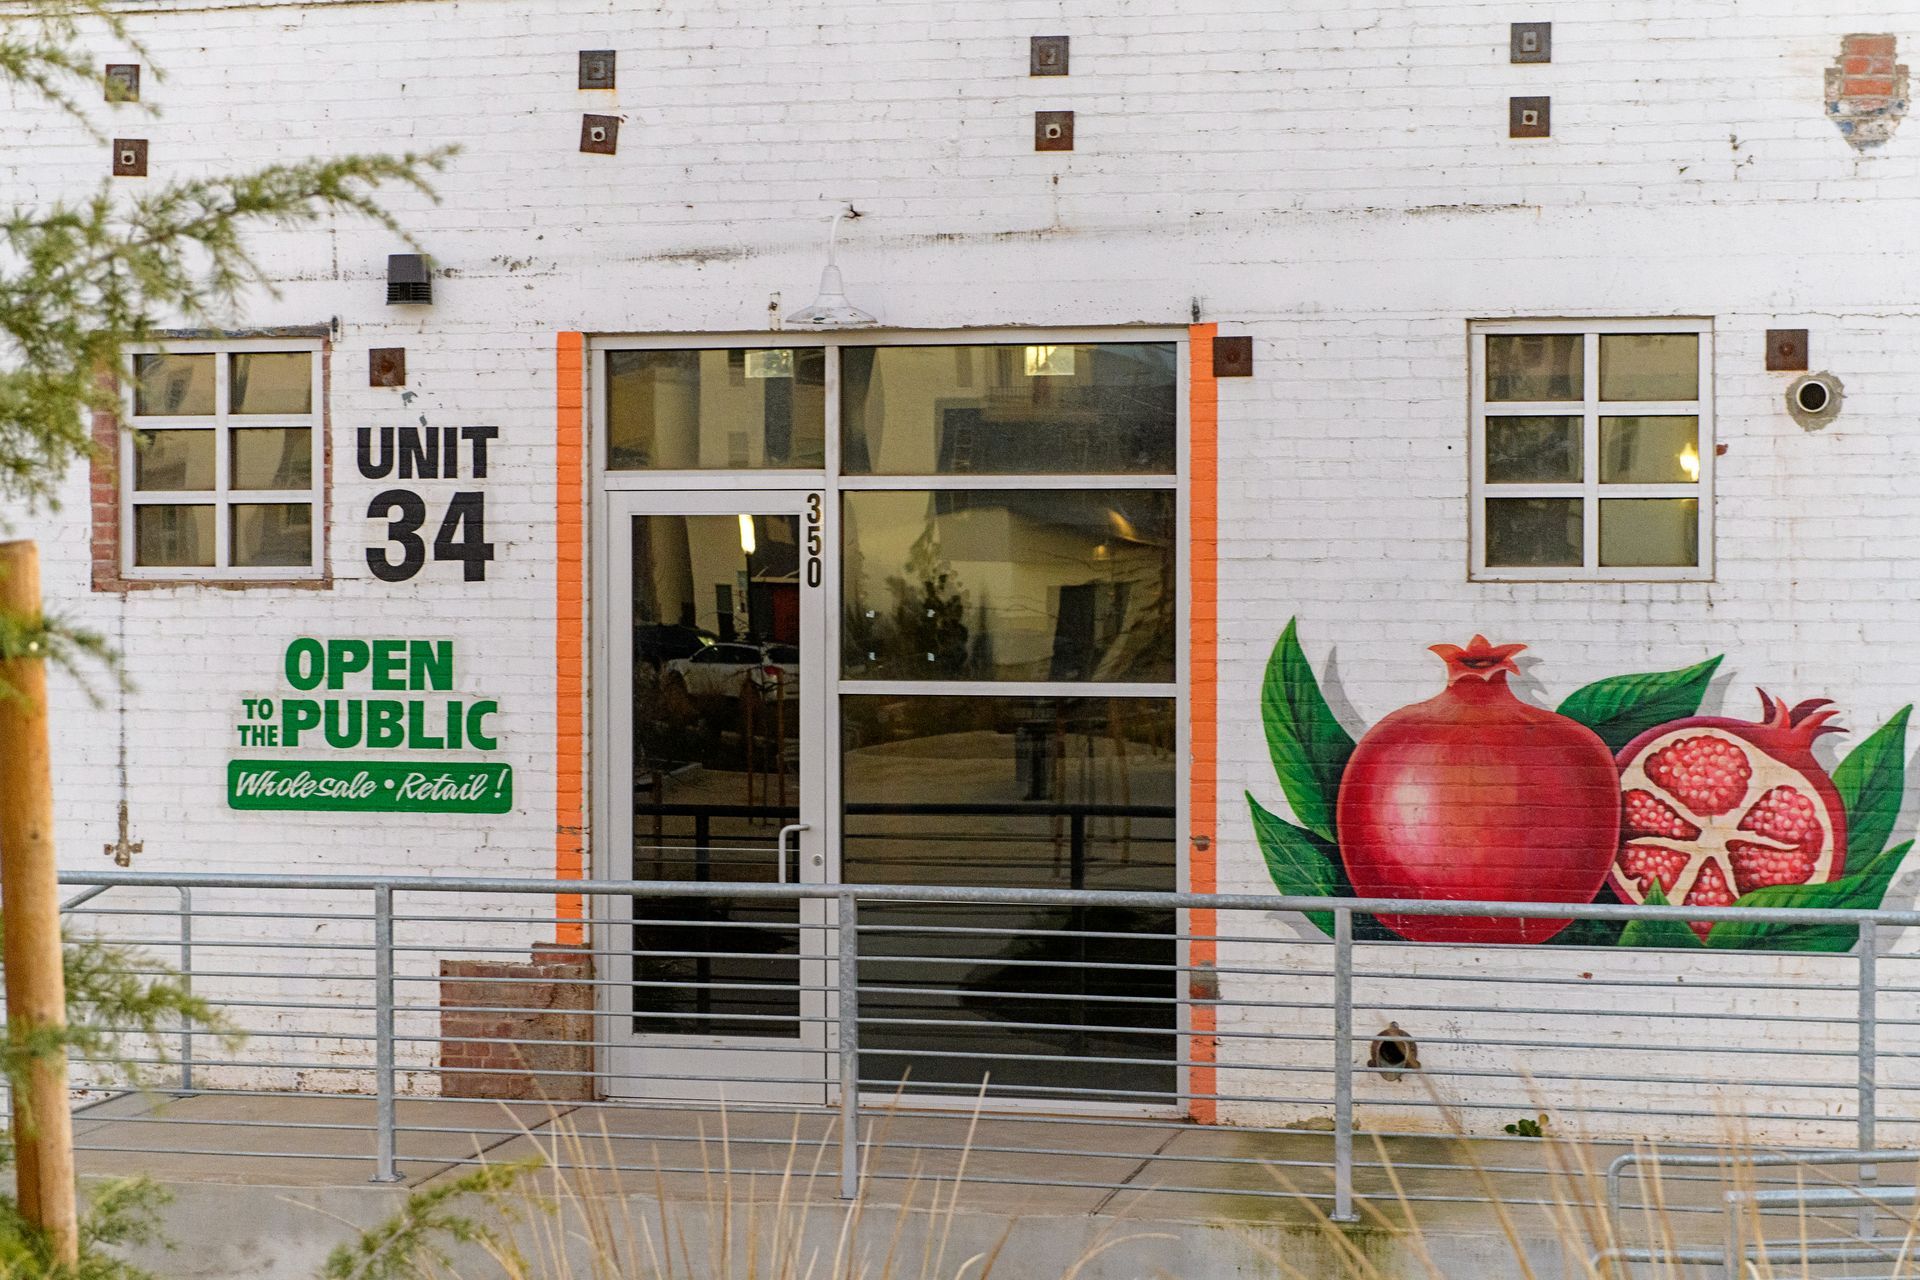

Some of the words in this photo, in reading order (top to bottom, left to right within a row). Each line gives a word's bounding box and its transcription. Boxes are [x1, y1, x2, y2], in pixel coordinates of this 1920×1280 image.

[356, 426, 498, 480] UNIT
[365, 489, 495, 582] 34
[807, 493, 821, 588] 350
[285, 637, 453, 691] OPEN
[242, 698, 273, 720] TO
[282, 698, 498, 750] PUBLIC
[237, 725, 279, 747] THE
[236, 769, 378, 800] Wholesale
